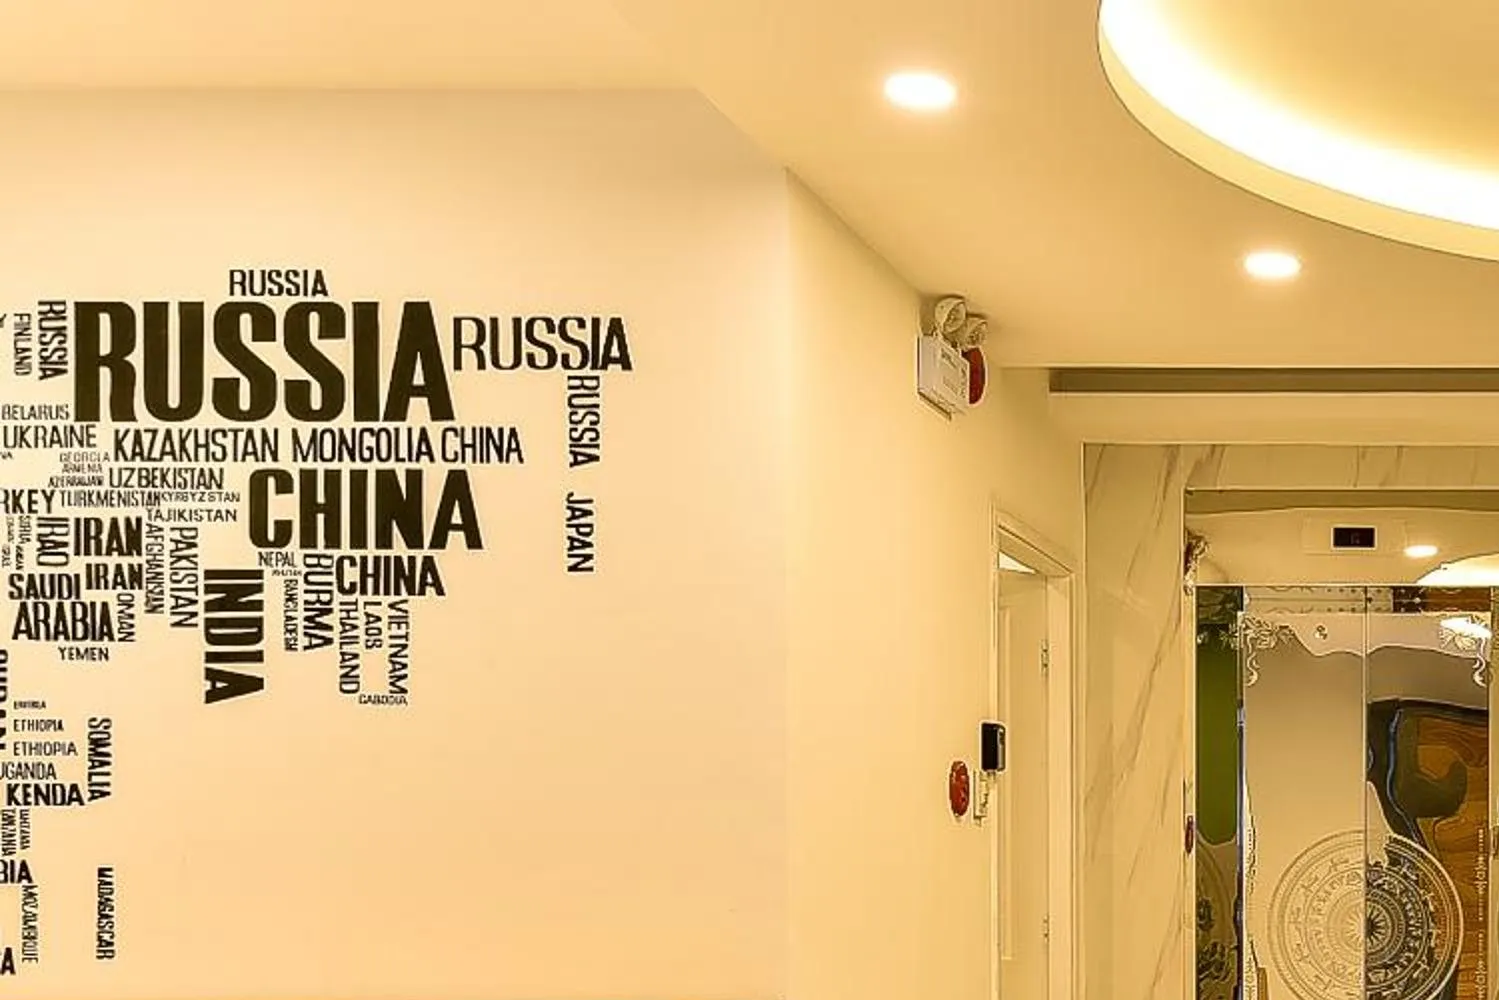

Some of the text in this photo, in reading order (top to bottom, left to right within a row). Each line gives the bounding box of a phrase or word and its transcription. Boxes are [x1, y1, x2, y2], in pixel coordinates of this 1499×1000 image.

[229, 269, 328, 297] RUSSIA
[13, 313, 32, 376] FINLAND
[37, 300, 68, 380] RUSSIA
[73, 300, 456, 422] RUSSIA
[452, 316, 633, 371] RUSSIA
[1, 404, 70, 420] BELARUS
[3, 424, 98, 449] UKRAINE
[566, 375, 601, 468] RUSSIA
[113, 427, 435, 463] KAZAKHSTAN MONGOLIA
[441, 427, 525, 464] CHINA
[108, 467, 225, 490] UZBEKISTAN
[147, 508, 238, 522] TAJIKISTAN
[249, 468, 484, 550] CHINA
[565, 491, 594, 573] JAPAN
[73, 516, 143, 557] IRAN
[258, 552, 296, 568] NEPAL
[8, 573, 81, 600] SAUDI
[85, 563, 143, 590] IRAN
[145, 522, 165, 615] AFGHANISTAN
[169, 526, 199, 628] PAKISTAN
[335, 555, 446, 597] CHINA
[12, 601, 115, 641] ARABIA
[117, 592, 136, 642] OMAN
[283, 579, 299, 652] BANGLADESH
[303, 553, 334, 651] BURMA
[364, 601, 383, 650] LAOS
[58, 647, 109, 662] YEMEN
[203, 569, 264, 704] INDIA
[339, 599, 361, 695] THAILAND
[388, 599, 411, 696] VIETNAM
[13, 719, 65, 733] ETHIOPIA
[13, 741, 79, 756] ETHIOPIA
[87, 717, 113, 802] SOMALIA
[6, 783, 86, 806] KENDA
[96, 866, 116, 961] MADAGASCAR
